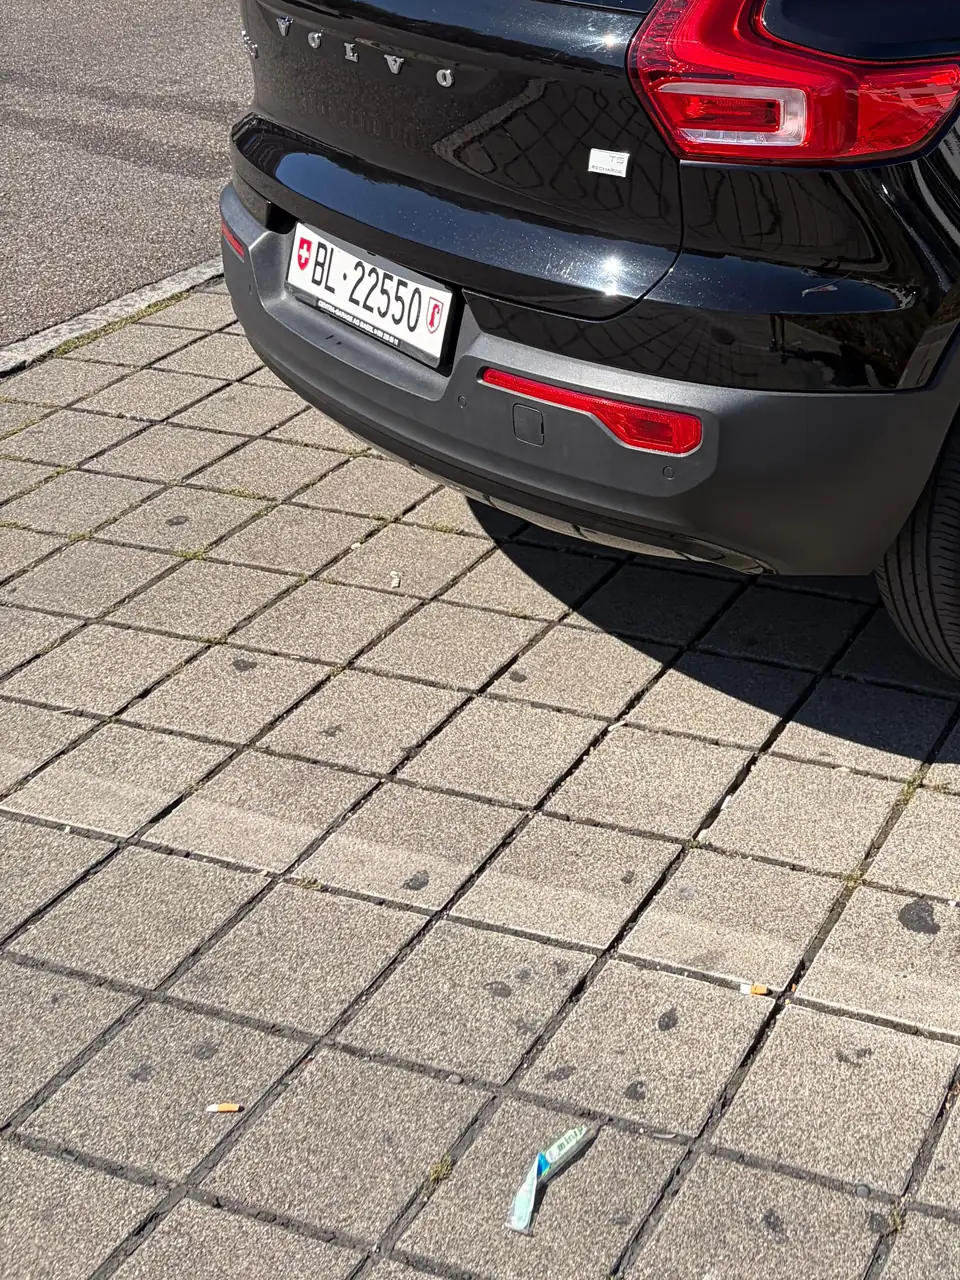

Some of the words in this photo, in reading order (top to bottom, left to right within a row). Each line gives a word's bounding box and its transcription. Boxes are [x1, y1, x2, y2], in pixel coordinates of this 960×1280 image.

[276, 16, 455, 88] VOLVO
[591, 164, 623, 175] RECHARGE
[348, 260, 422, 332] 22550
